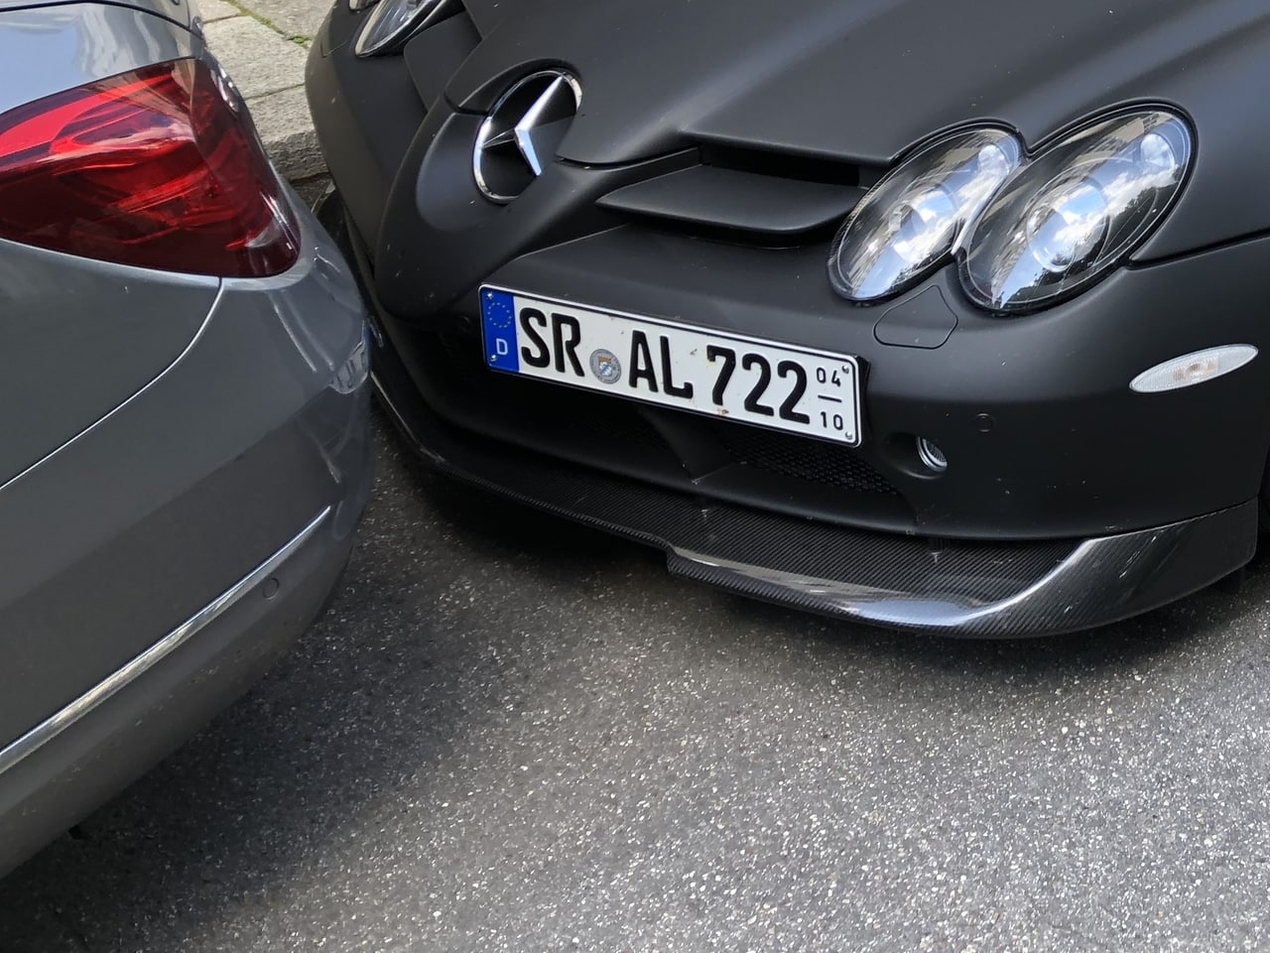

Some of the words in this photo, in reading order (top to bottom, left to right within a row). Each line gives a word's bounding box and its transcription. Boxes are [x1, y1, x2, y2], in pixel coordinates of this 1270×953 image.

[496, 338, 508, 355] D
[520, 307, 585, 377] SR
[629, 331, 694, 400] AL
[707, 345, 810, 425] 722
[816, 366, 842, 387] 04
[820, 411, 844, 431] 10
